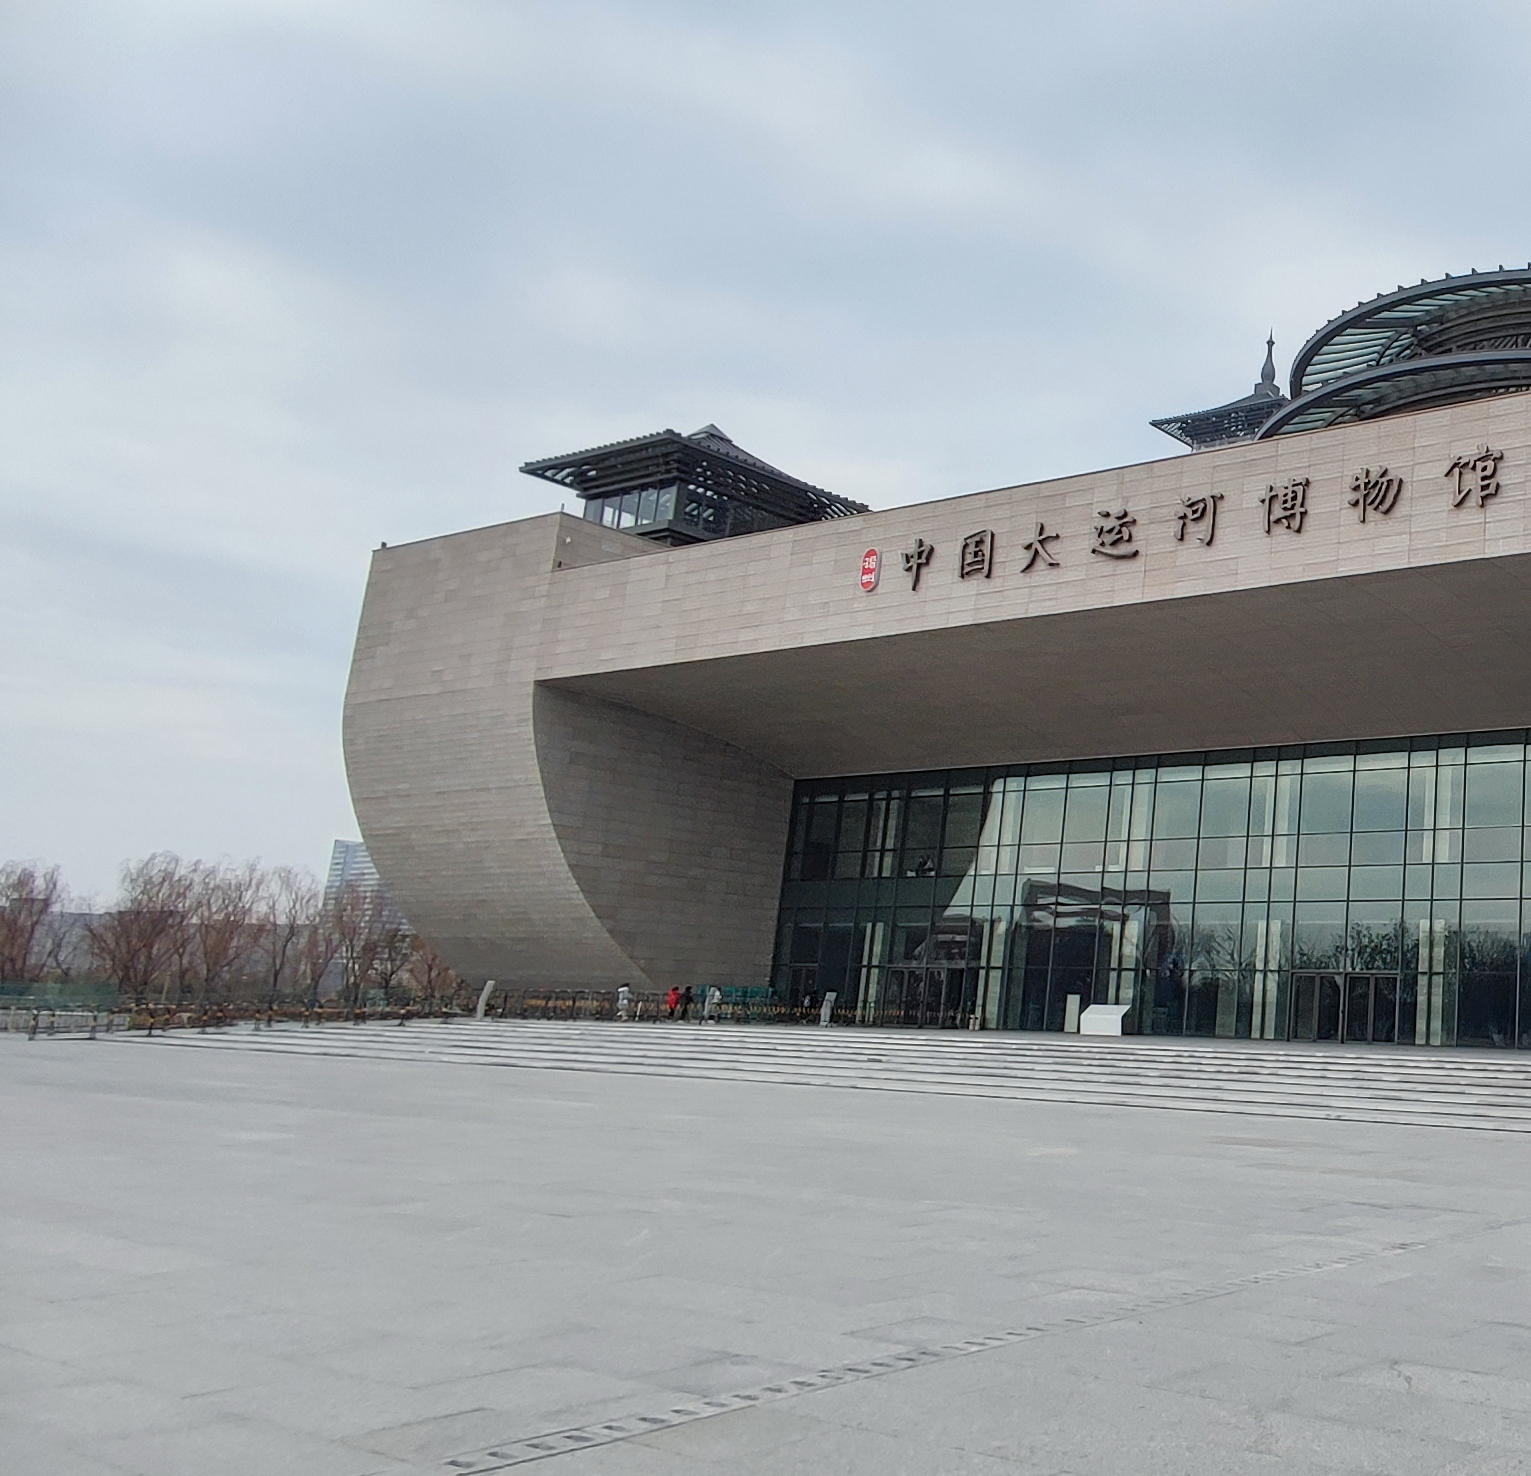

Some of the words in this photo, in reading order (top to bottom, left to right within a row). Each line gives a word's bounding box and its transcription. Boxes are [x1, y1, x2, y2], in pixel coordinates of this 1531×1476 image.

[901, 443, 1504, 592] 中国大运河博物馆
